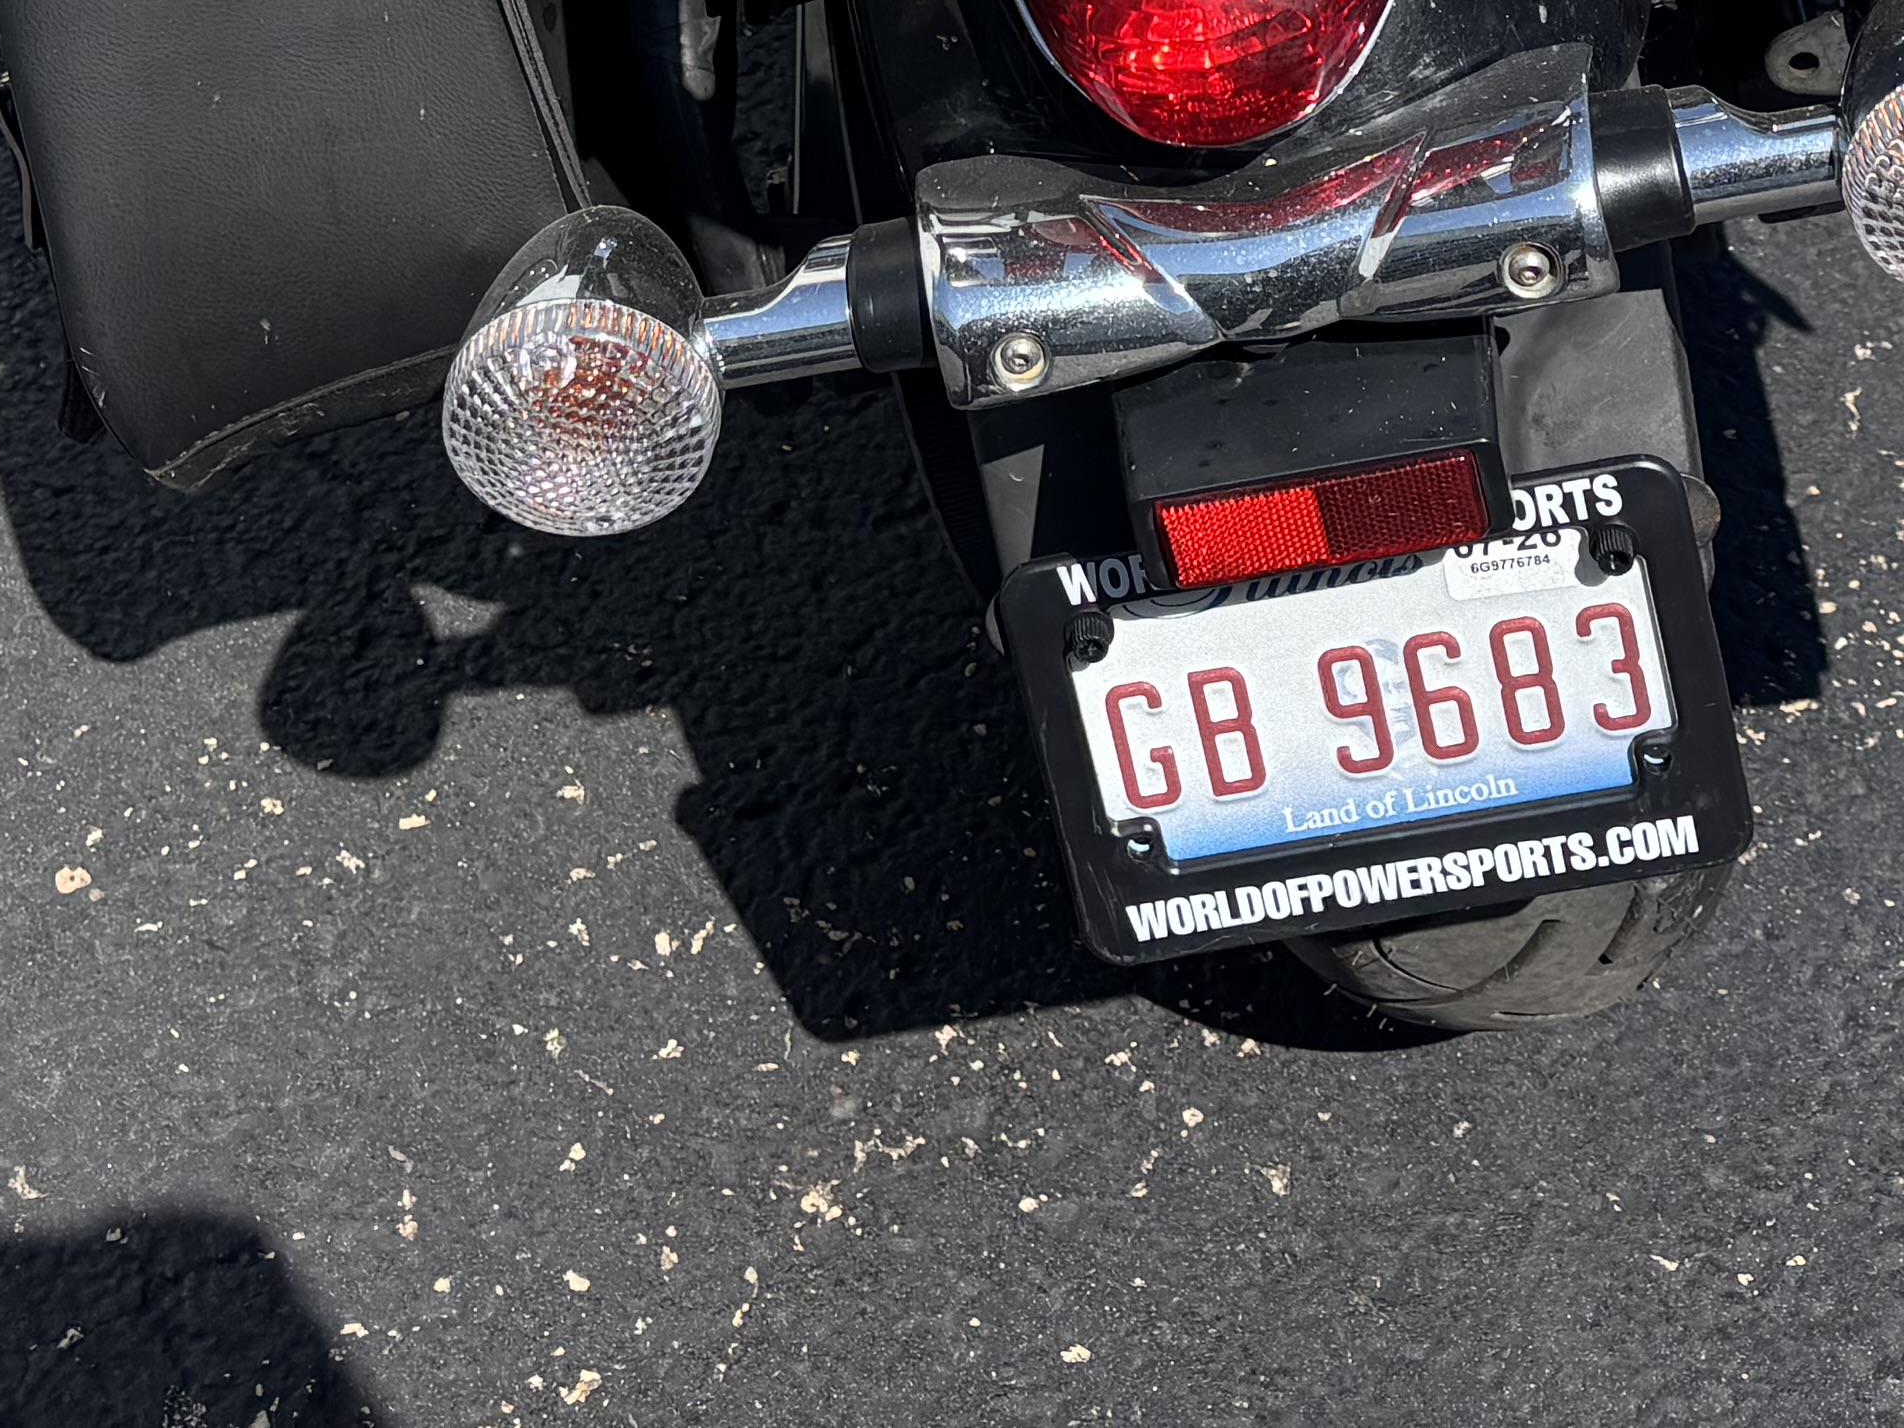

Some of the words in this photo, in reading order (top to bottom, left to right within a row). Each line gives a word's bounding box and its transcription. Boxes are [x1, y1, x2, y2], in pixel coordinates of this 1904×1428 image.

[1104, 665, 1266, 809] GB
[1317, 601, 1652, 775] 9683
[1282, 799, 1360, 834] Land
[1365, 790, 1398, 819] of
[1403, 774, 1519, 814] Lincoln
[1126, 813, 1700, 943] WORLDOFPOWERSPORTS.COM
